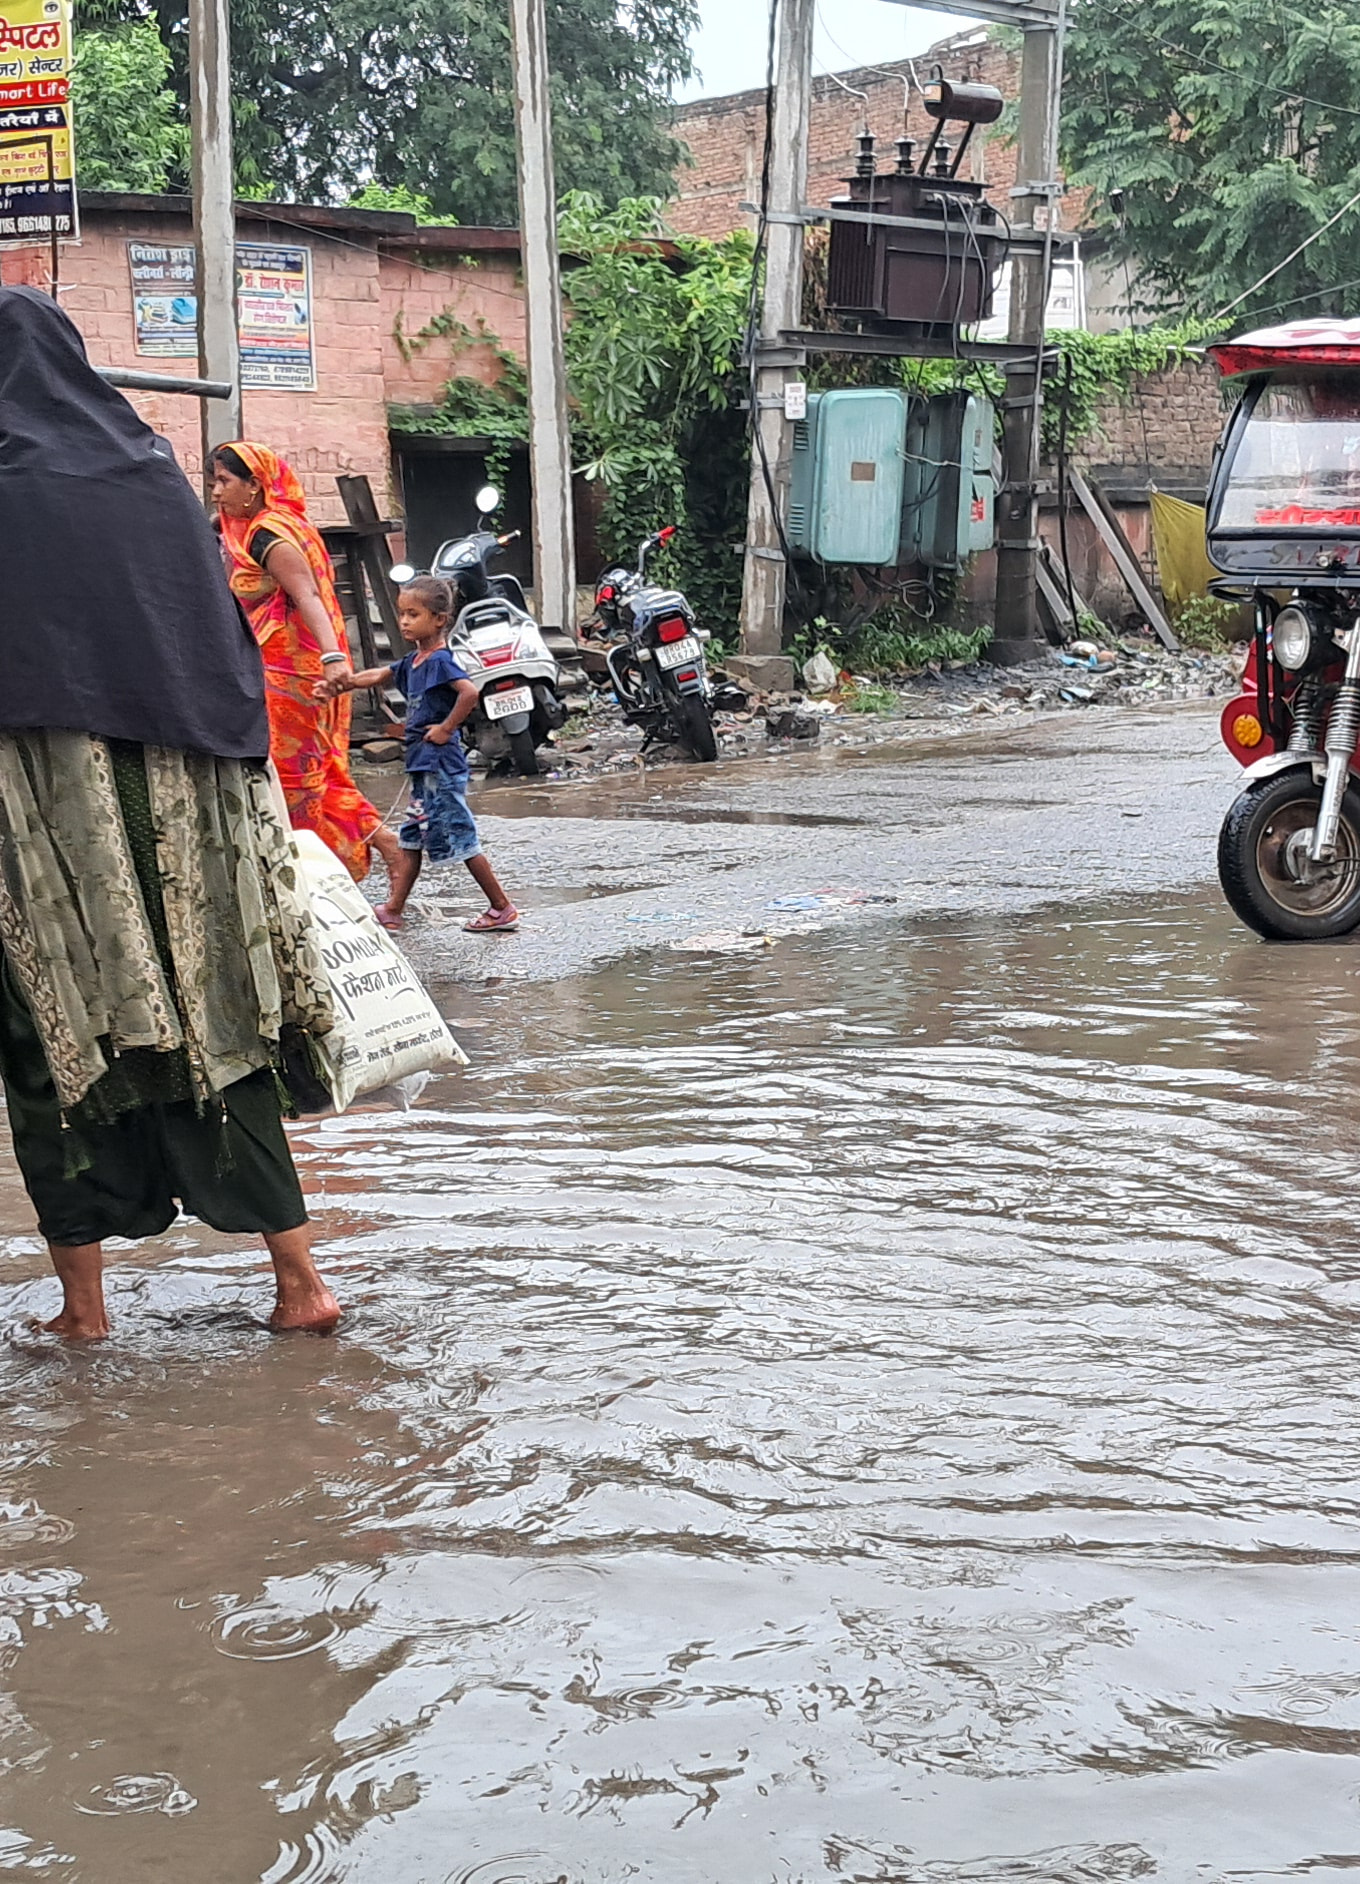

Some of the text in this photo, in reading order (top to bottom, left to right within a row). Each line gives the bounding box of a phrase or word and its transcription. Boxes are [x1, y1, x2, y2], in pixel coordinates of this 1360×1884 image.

[29, 55, 63, 75] सेन्टर
[45, 109, 60, 125] में
[320, 931, 386, 970] BOMBAY
